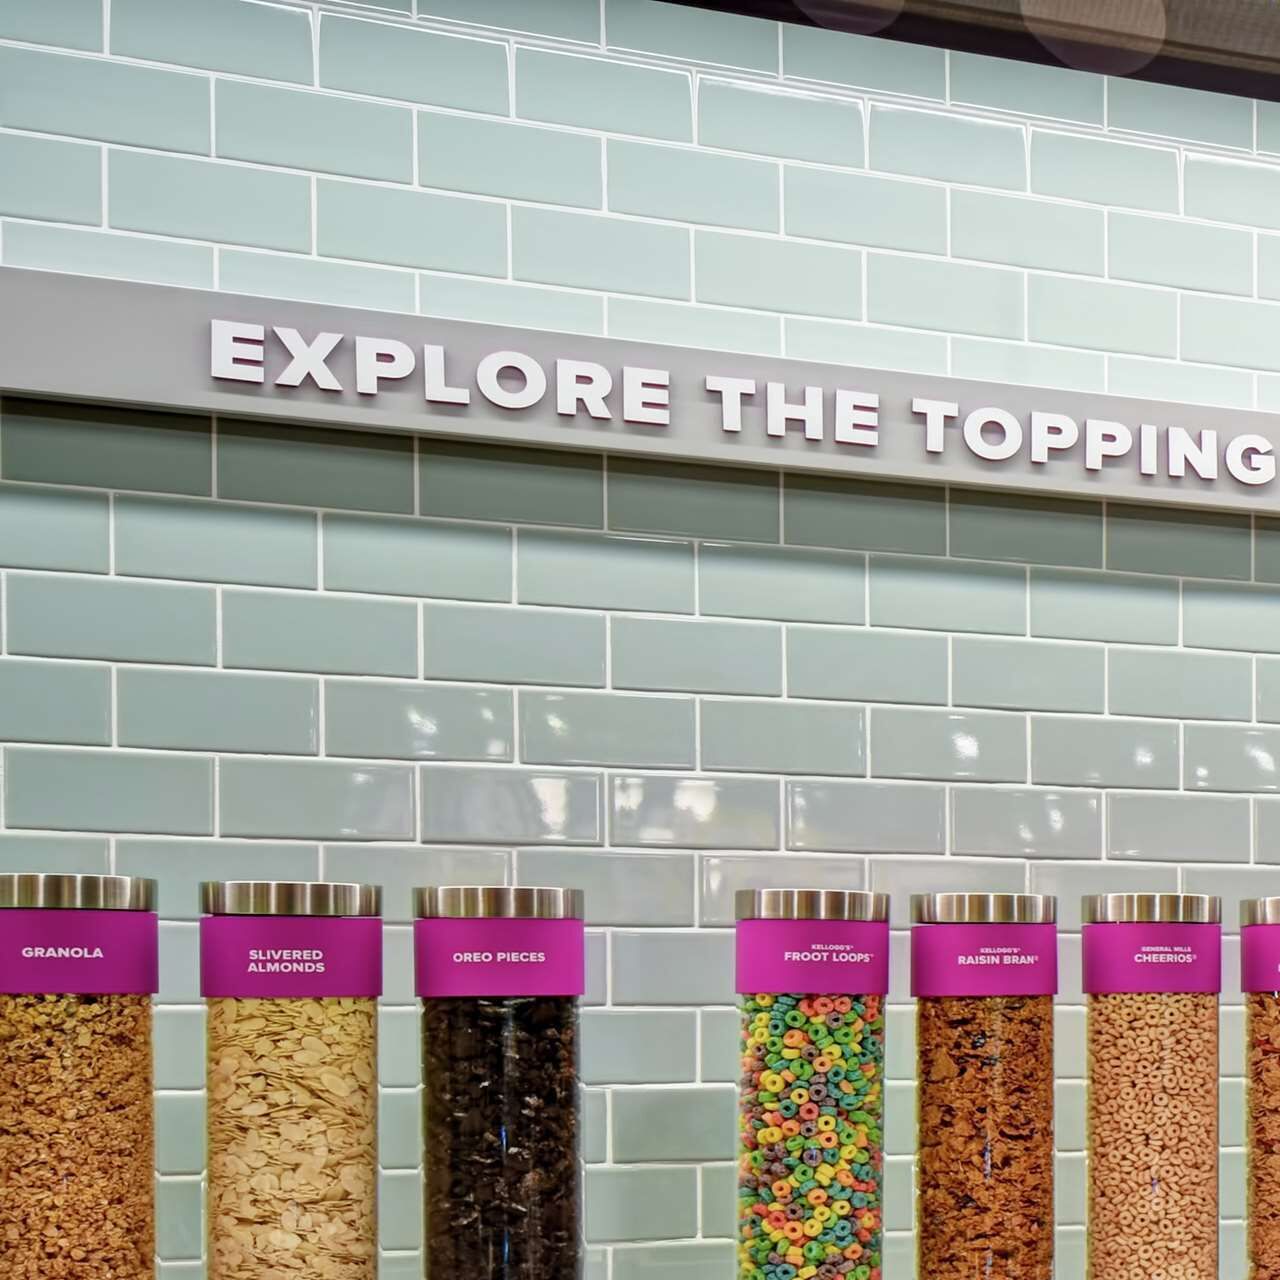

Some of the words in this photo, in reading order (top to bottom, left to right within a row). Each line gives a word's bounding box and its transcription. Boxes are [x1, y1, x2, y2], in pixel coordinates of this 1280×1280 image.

[209, 319, 671, 427] EXPLORE
[705, 374, 880, 447] THE
[911, 397, 1276, 486] TOPPING
[21, 947, 104, 958] GRANOLA
[249, 950, 323, 960] SLIVERED
[453, 952, 493, 962] OREO
[497, 952, 545, 962] PIECES
[784, 951, 828, 962] FROOT
[958, 955, 1000, 965] RAISIN
[248, 962, 325, 973] ALMONDS
